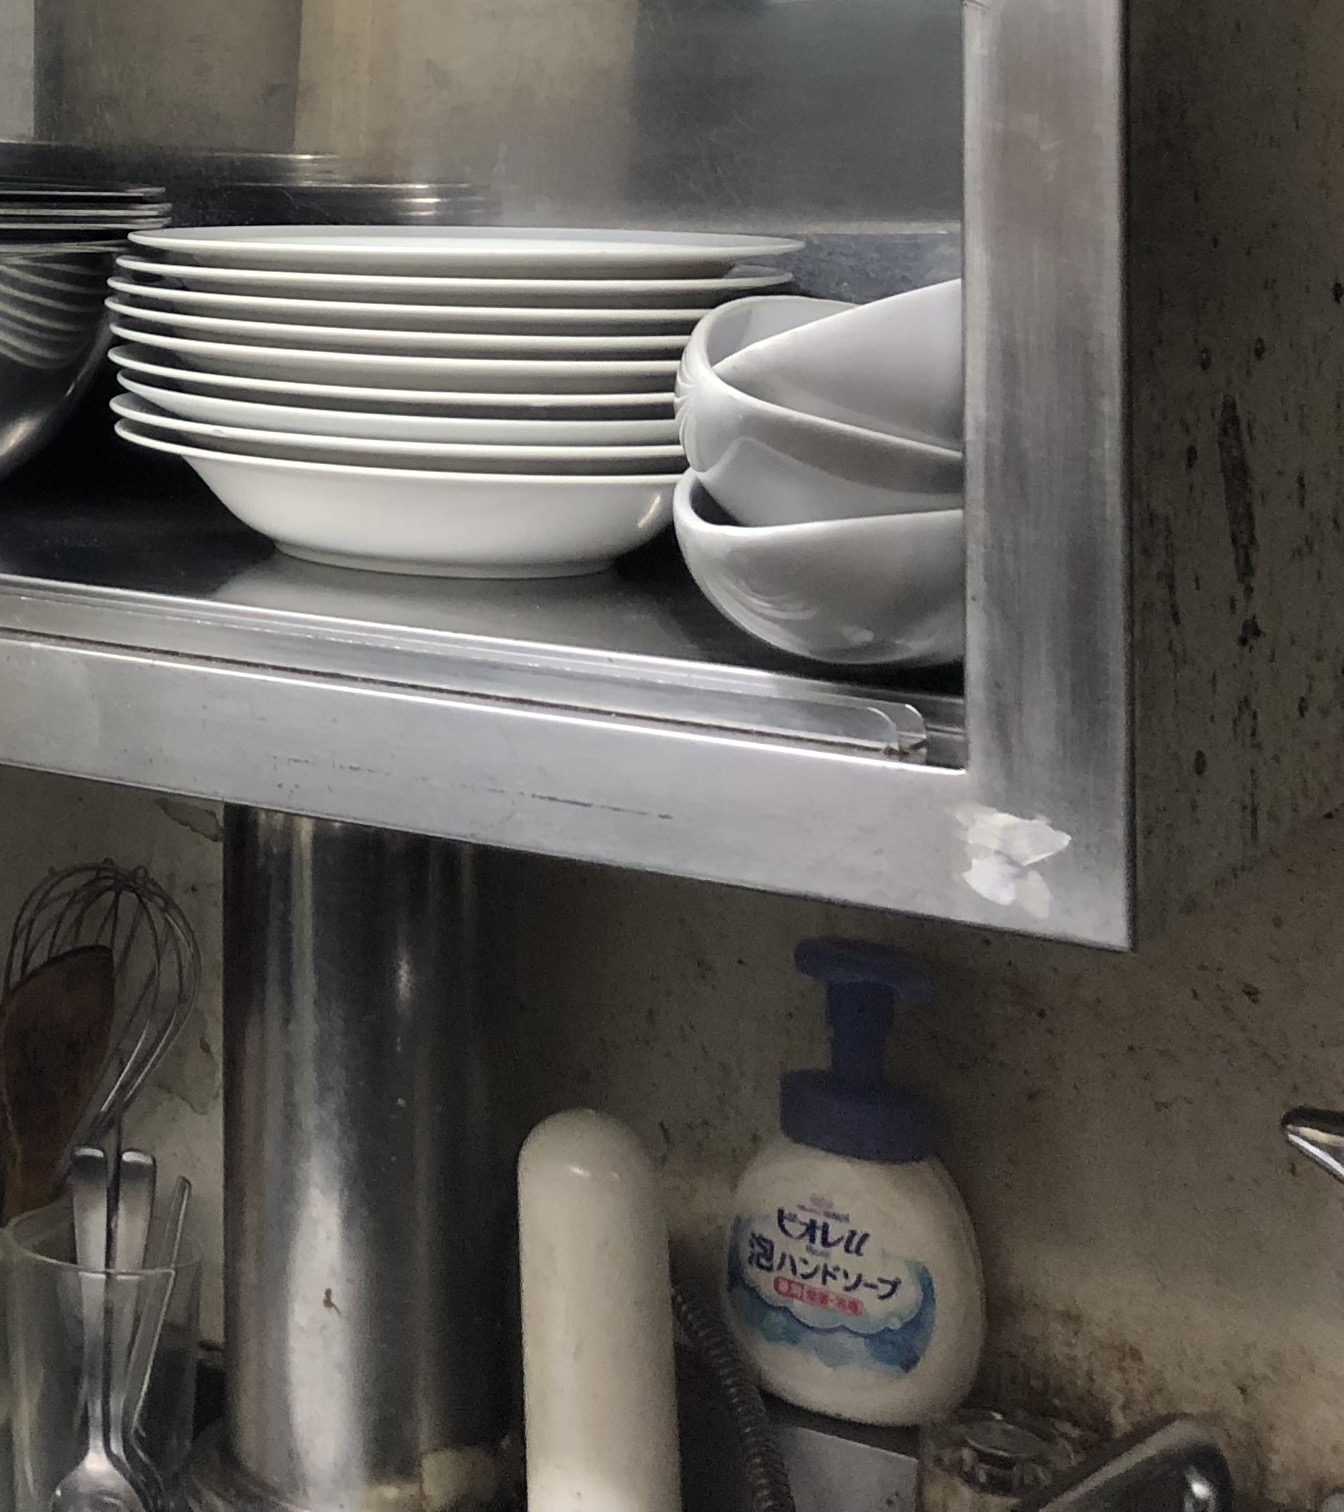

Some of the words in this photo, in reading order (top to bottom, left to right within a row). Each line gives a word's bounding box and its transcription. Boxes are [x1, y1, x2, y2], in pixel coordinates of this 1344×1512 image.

[748, 1232, 902, 1300] 泡ハンドソープ
